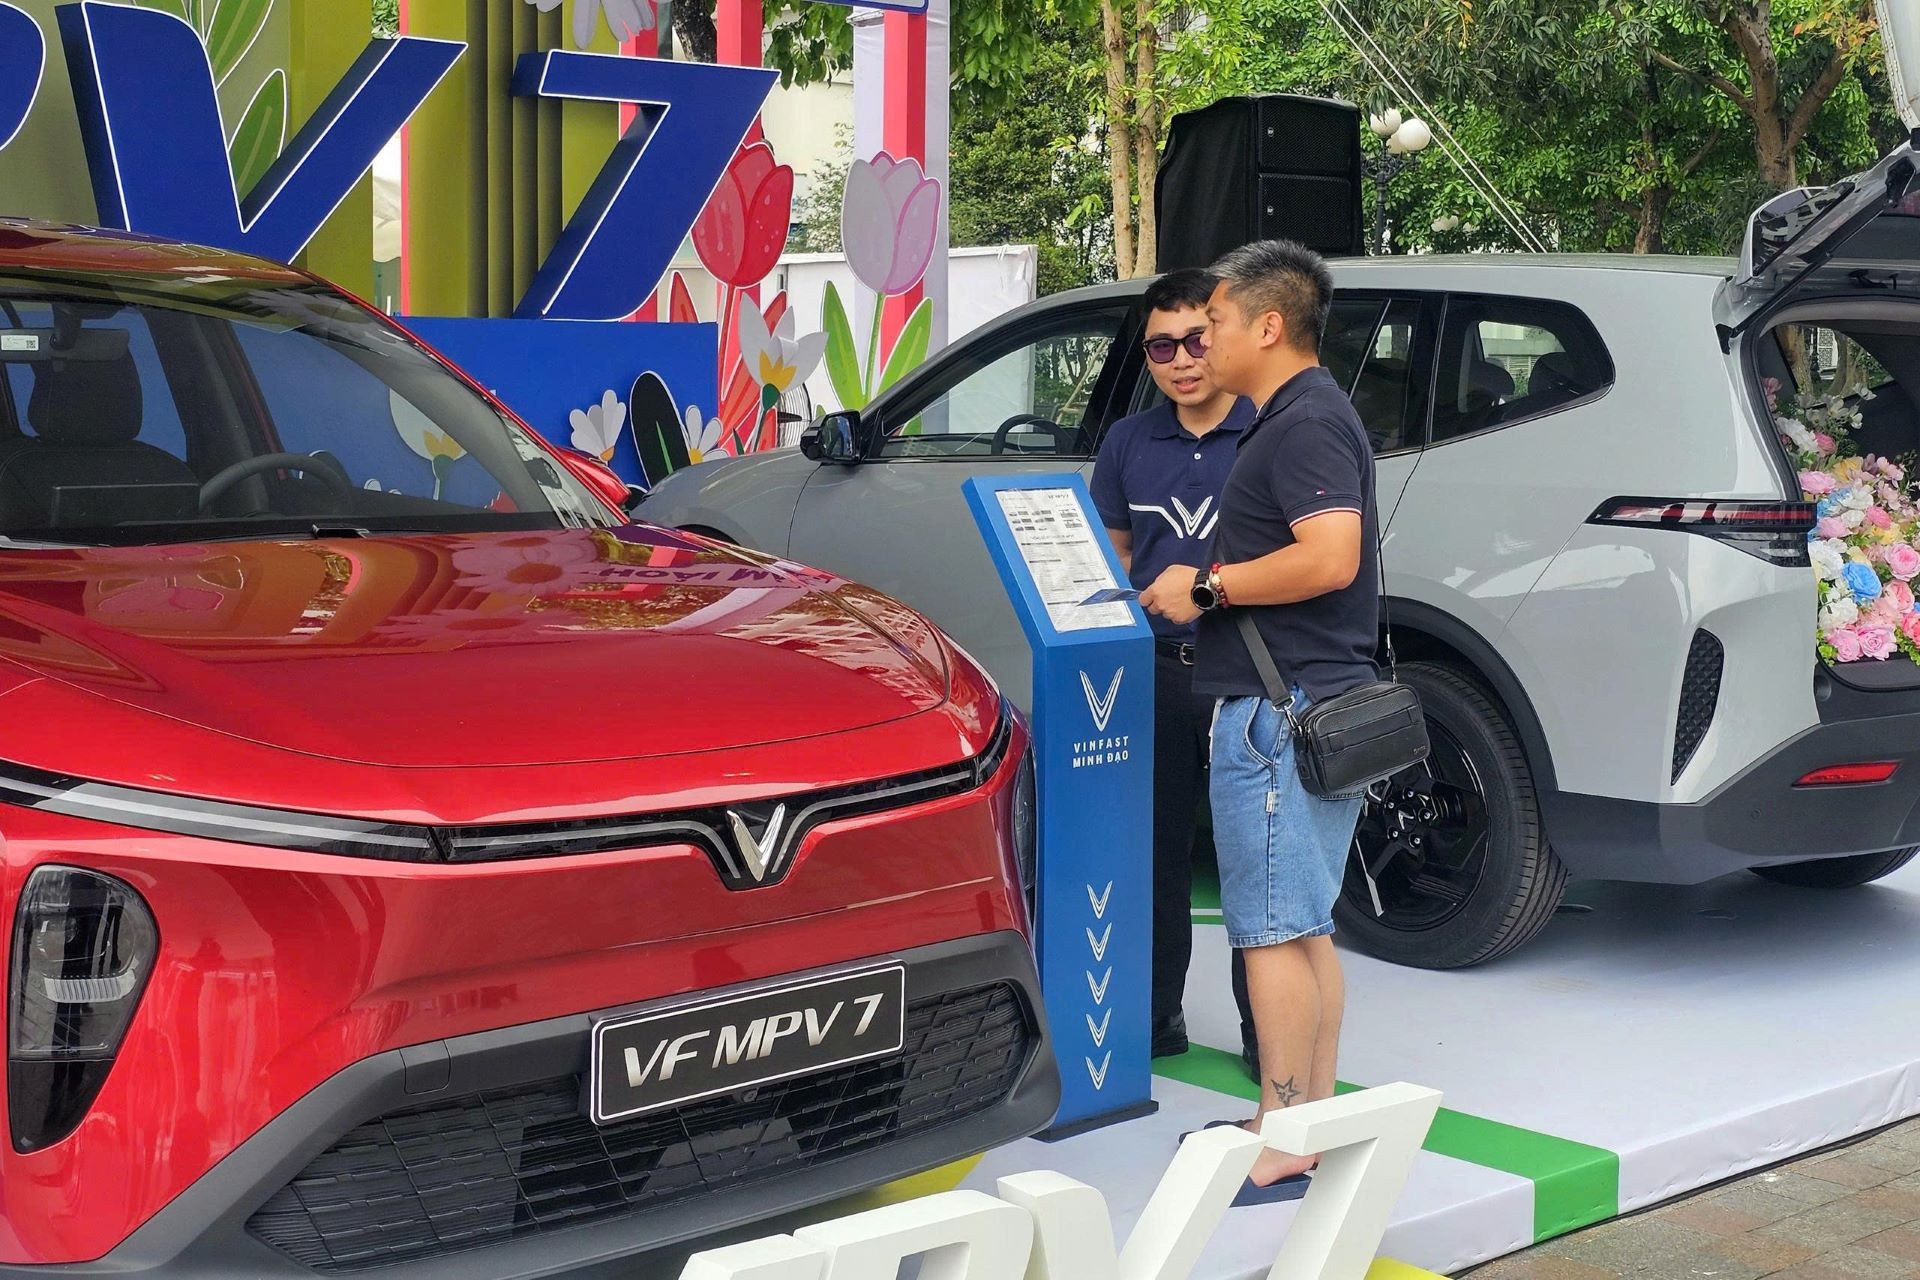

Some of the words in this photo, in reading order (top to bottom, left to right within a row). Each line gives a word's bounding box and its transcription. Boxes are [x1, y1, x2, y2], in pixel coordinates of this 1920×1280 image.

[512, 48, 780, 322] 7
[1073, 735, 1129, 753] VINFAST
[1073, 754, 1103, 769] MINH
[1106, 750, 1129, 764] ĐẠO
[623, 1029, 711, 1089] VF
[711, 1000, 845, 1069] MPV
[852, 991, 885, 1037] 7
[1260, 1080, 1444, 1280] 7
